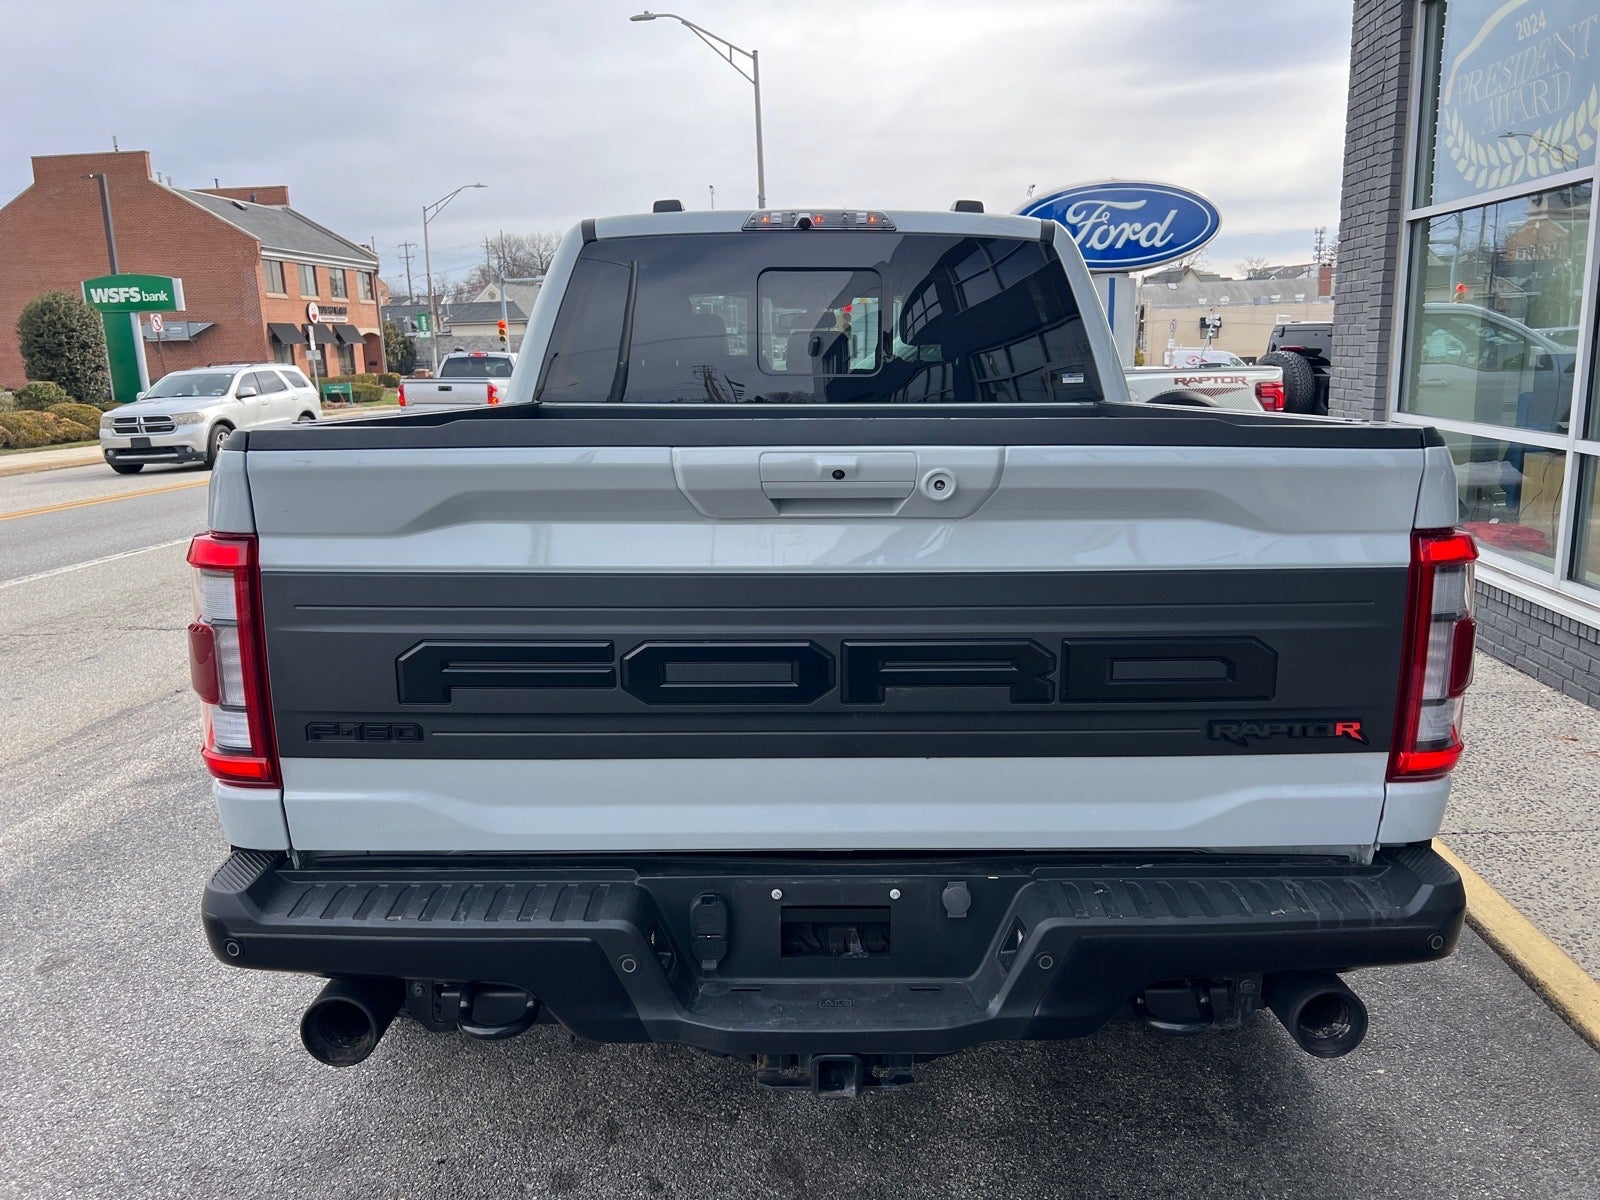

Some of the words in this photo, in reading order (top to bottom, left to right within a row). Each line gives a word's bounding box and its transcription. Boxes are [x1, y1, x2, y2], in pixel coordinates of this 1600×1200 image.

[1515, 9, 1546, 41] 2024
[1481, 70, 1572, 135] AWARD
[1066, 199, 1178, 250] Ford
[90, 287, 141, 304] WSFS
[142, 290, 168, 302] bank
[1174, 375, 1249, 387] RAPTOR
[395, 637, 1279, 706] FORD
[305, 721, 424, 743] F-150
[1207, 719, 1369, 747] RAPTOR
